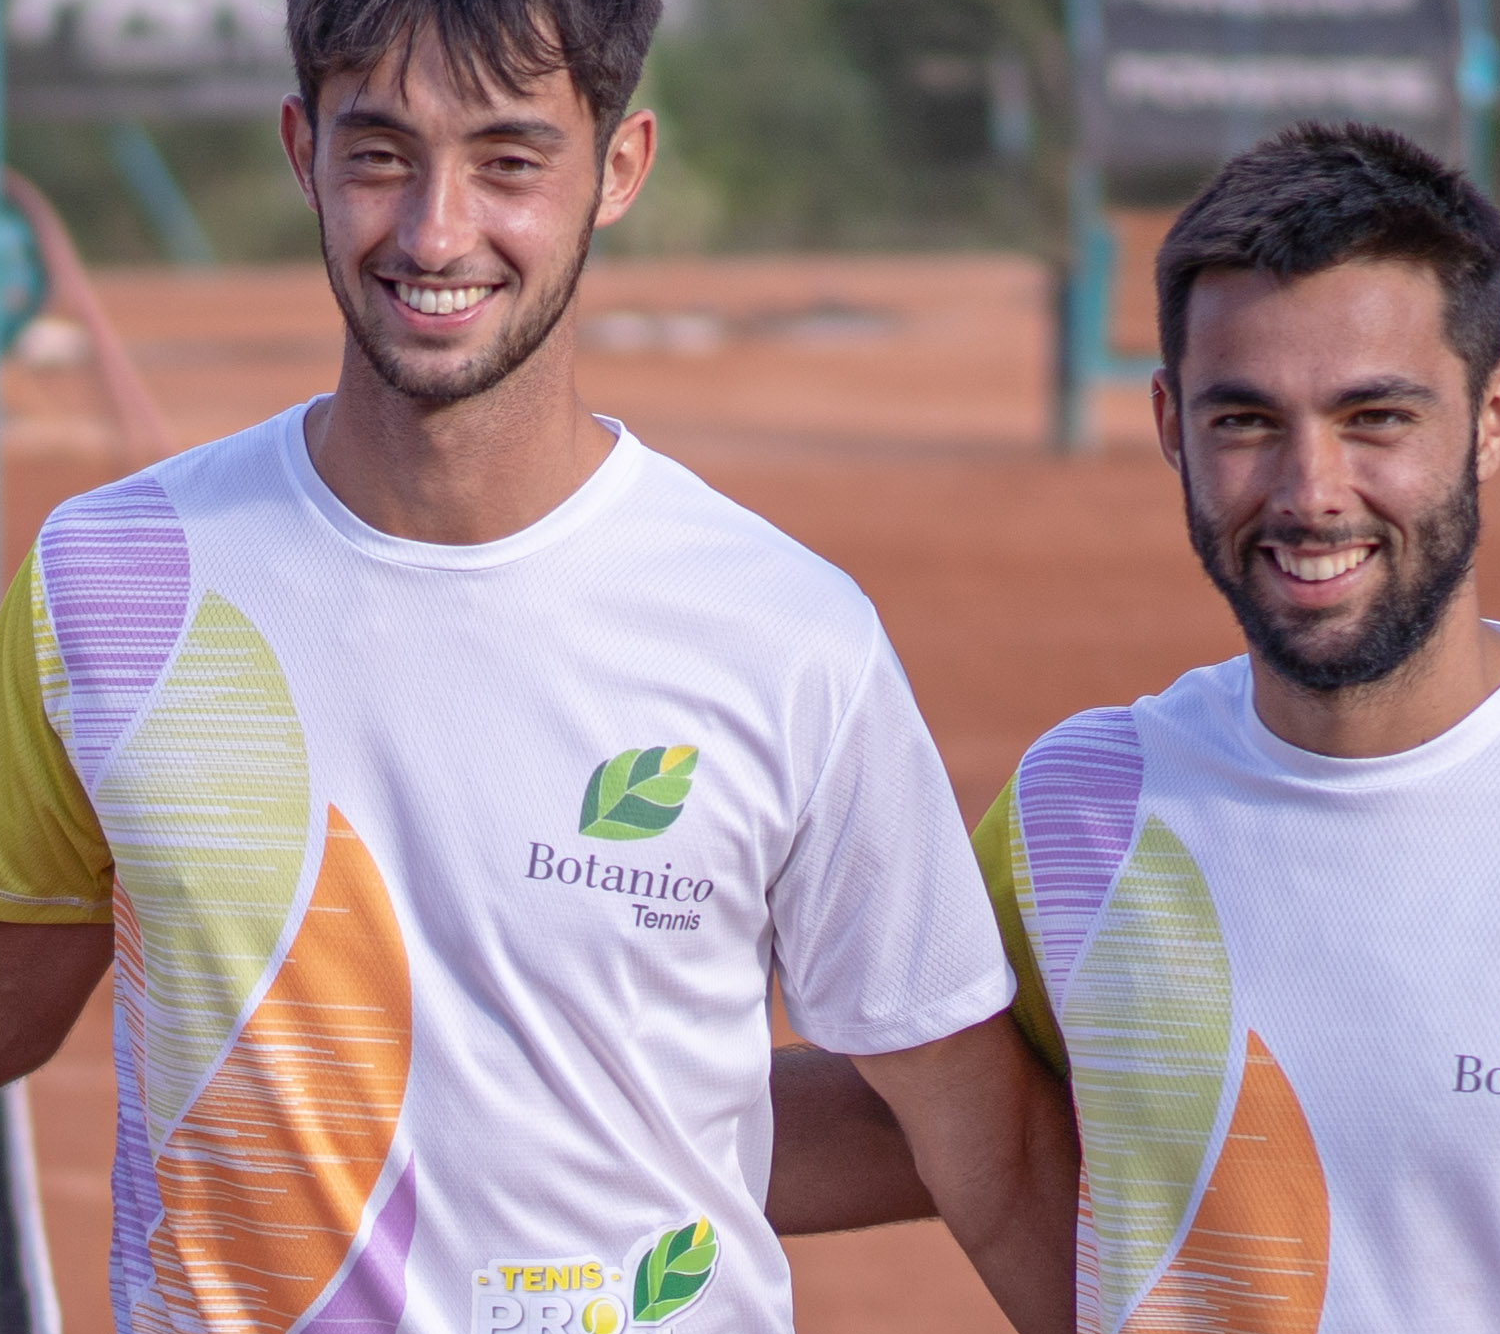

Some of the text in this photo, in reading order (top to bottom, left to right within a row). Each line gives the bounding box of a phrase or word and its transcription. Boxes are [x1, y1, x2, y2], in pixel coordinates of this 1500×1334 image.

[523, 841, 714, 903] Botanico
[631, 903, 701, 931] Tennis
[499, 1262, 603, 1292] TENIS
